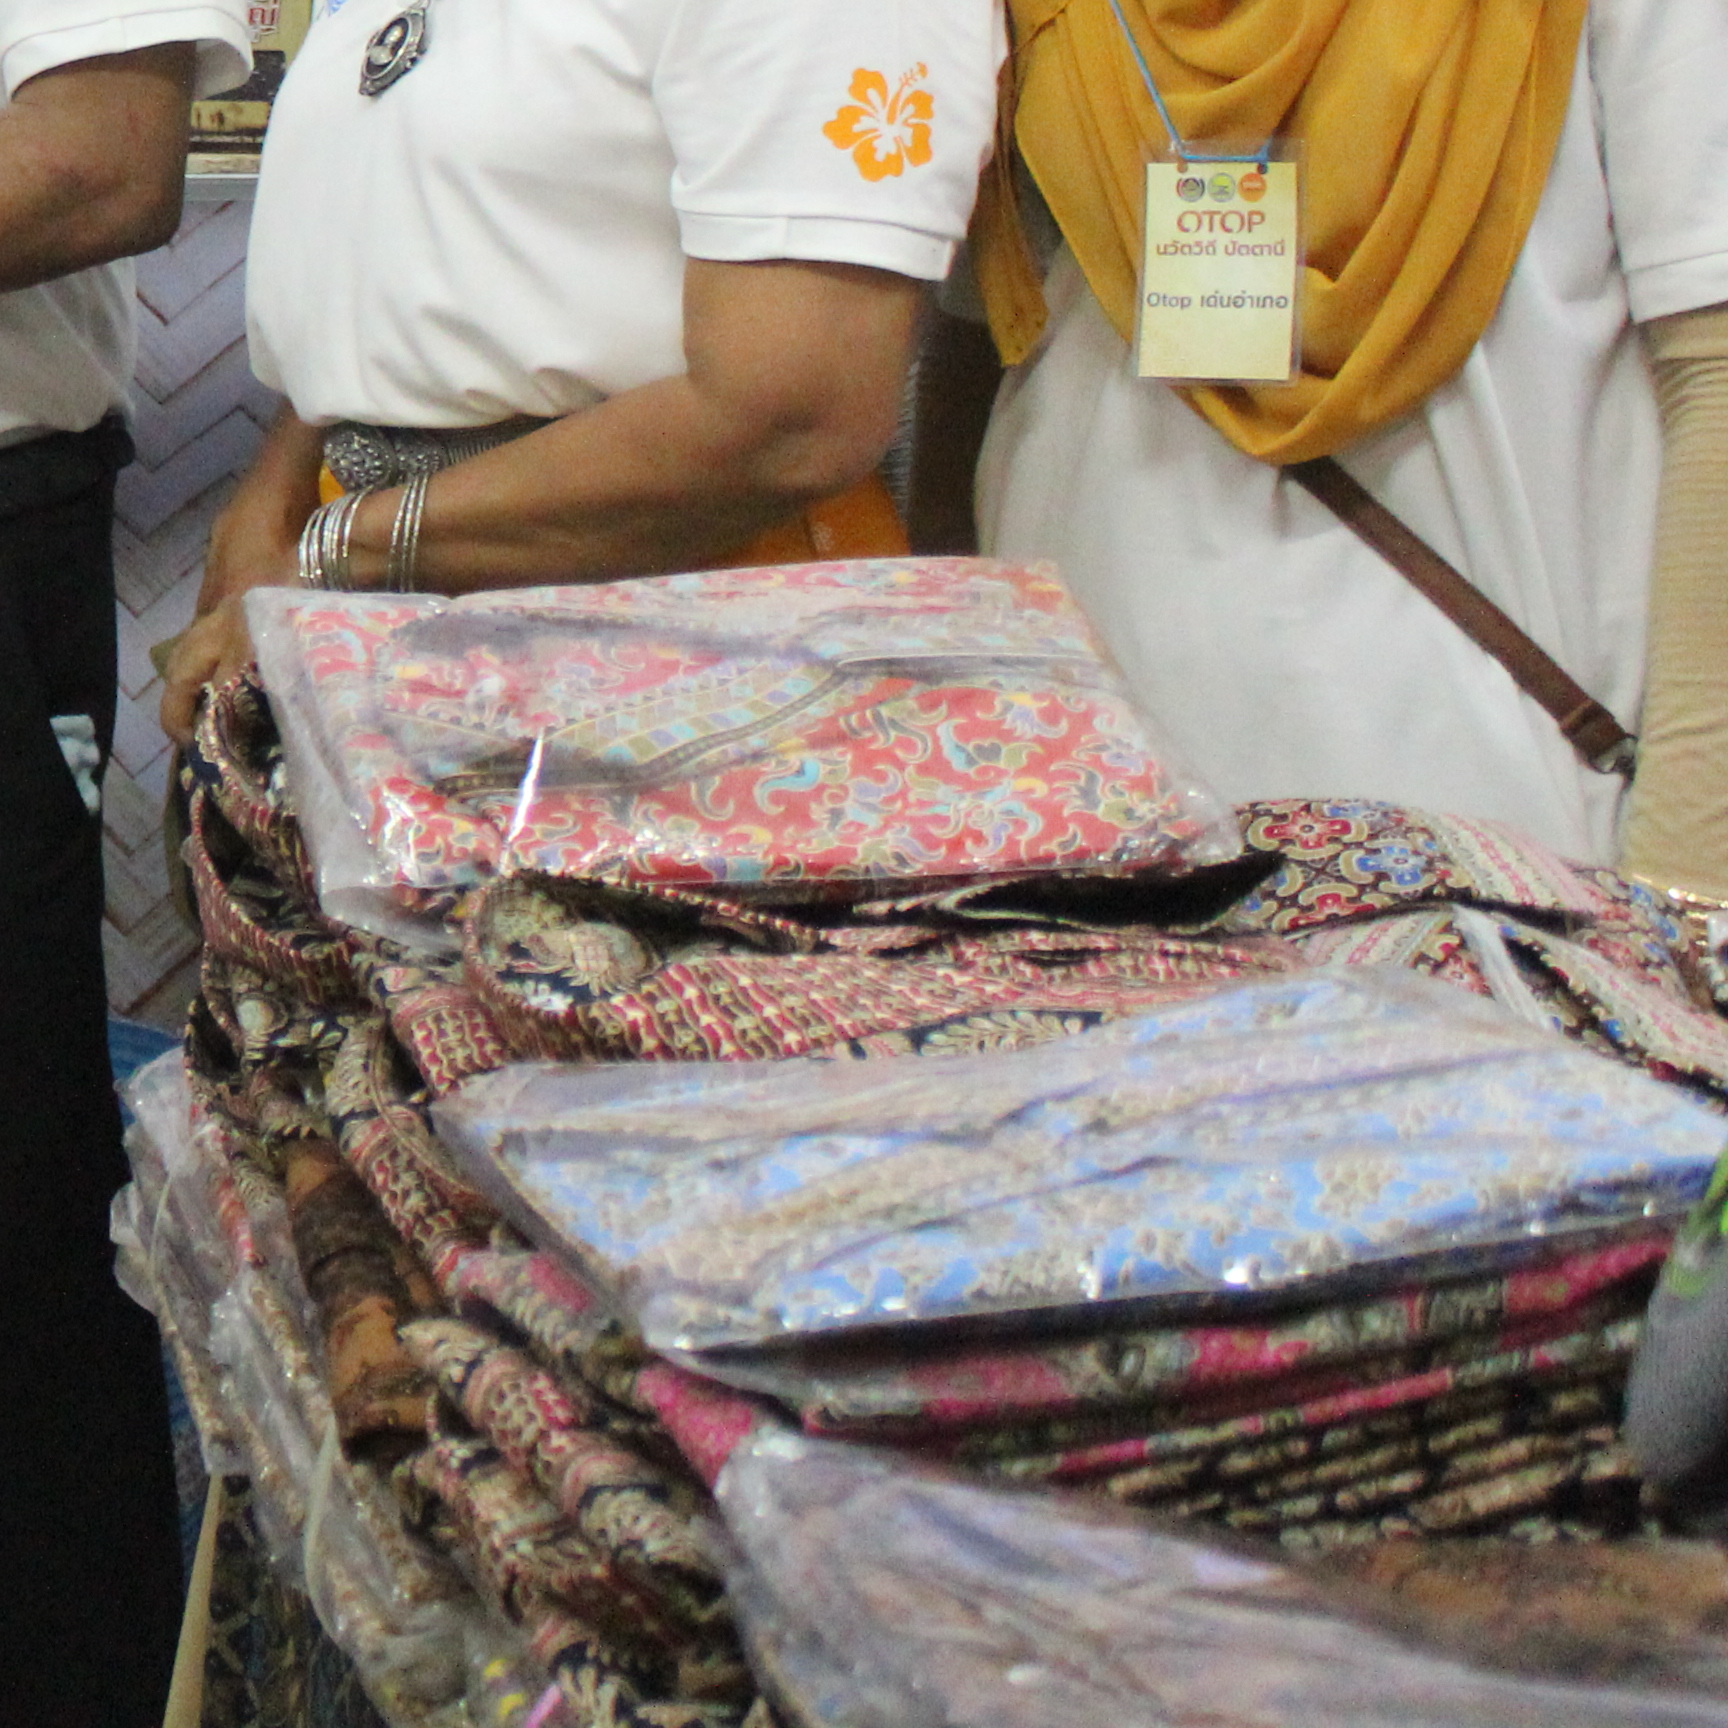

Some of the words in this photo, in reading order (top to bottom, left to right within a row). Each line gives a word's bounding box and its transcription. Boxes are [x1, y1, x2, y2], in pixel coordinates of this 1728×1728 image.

[1177, 210, 1266, 233] OTOP
[1225, 239, 1285, 256] ปัตตานี
[1147, 292, 1191, 310] Otop
